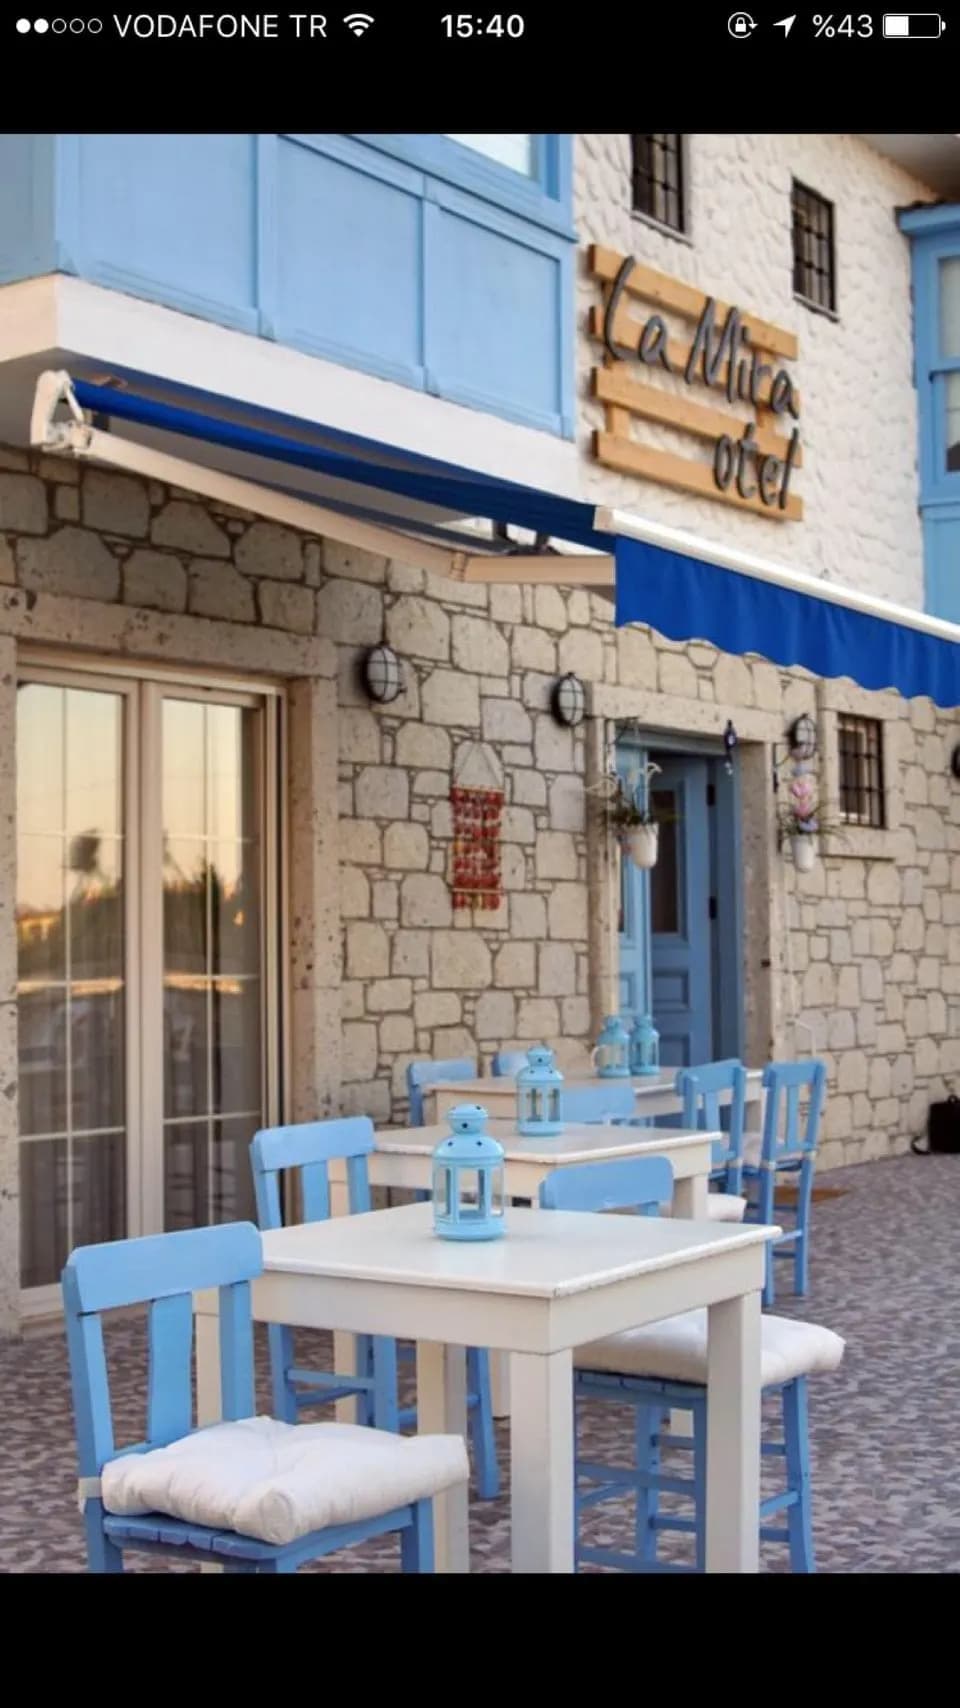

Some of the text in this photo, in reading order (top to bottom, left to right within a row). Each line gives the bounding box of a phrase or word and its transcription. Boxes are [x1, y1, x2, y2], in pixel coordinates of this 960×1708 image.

[603, 255, 798, 420] La Mira
[713, 422, 798, 510] otel
